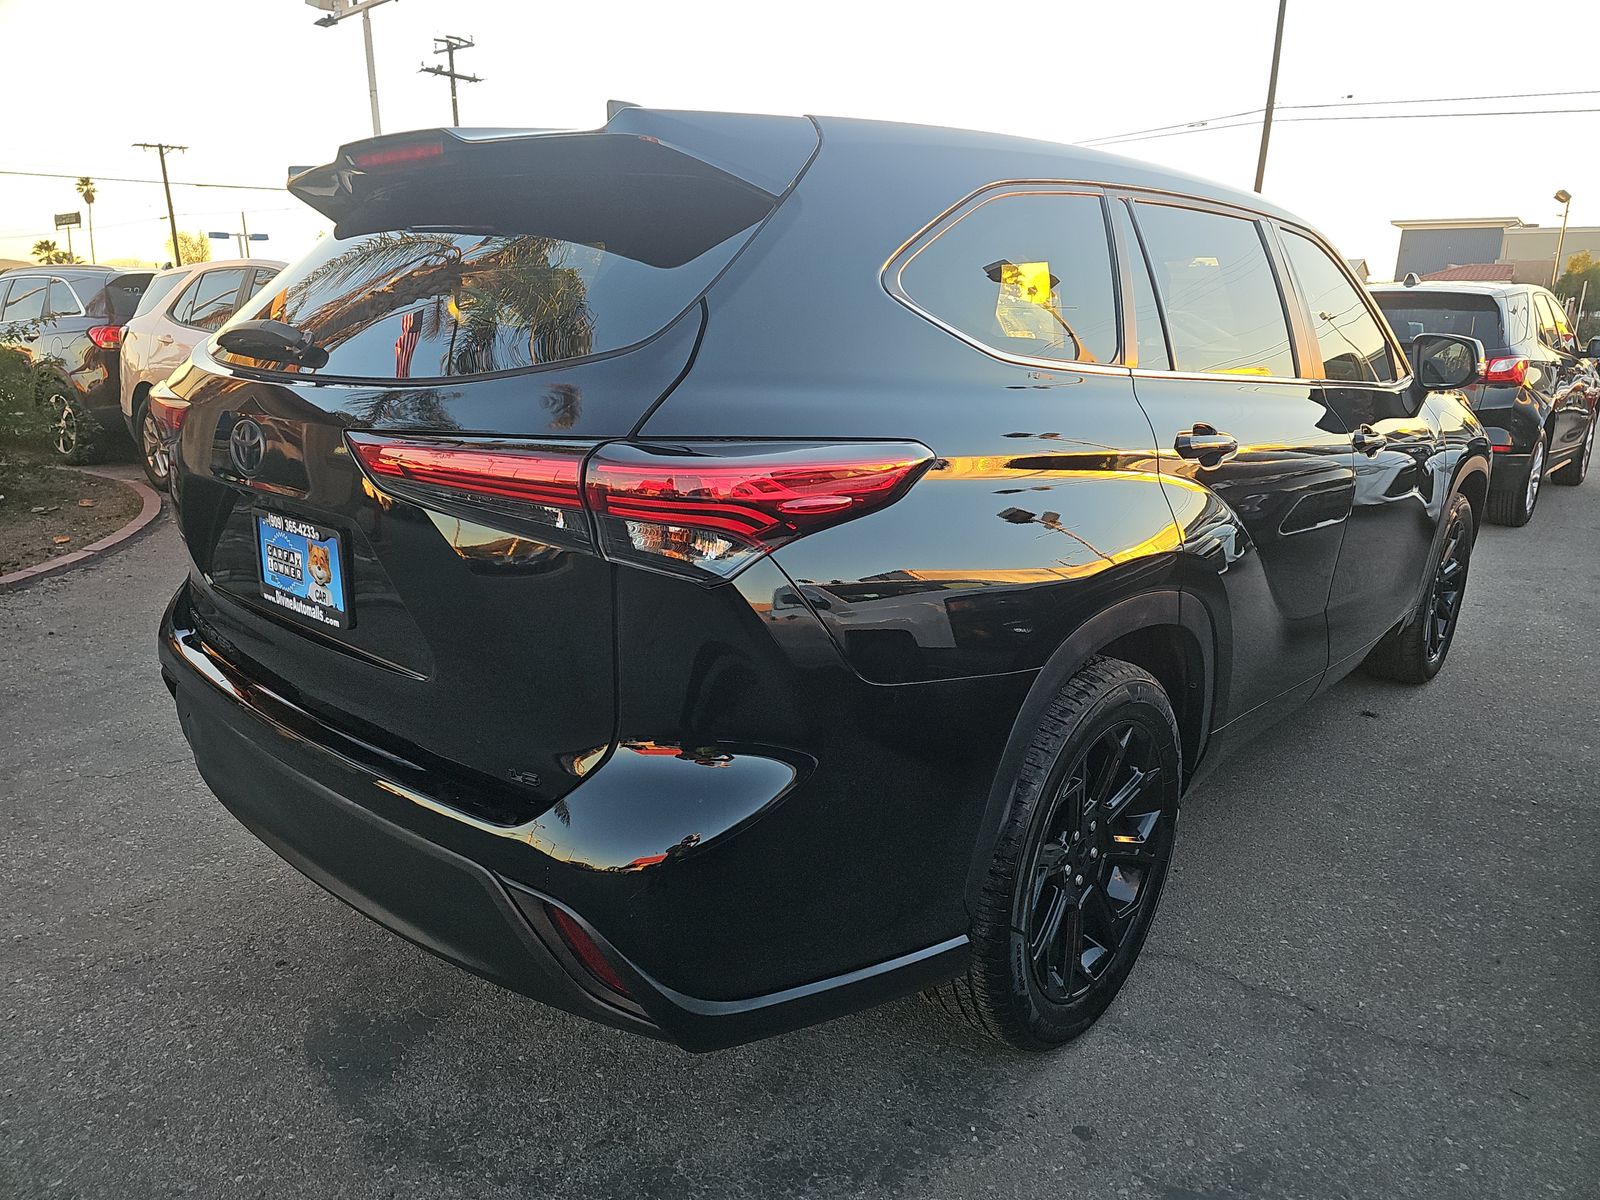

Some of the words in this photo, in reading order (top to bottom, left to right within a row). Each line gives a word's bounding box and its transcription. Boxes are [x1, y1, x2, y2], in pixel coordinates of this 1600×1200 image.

[267, 512, 284, 531] (909)
[284, 518, 316, 539] 365-4233
[267, 545, 301, 567] CARFAX
[314, 589, 327, 604] CAR
